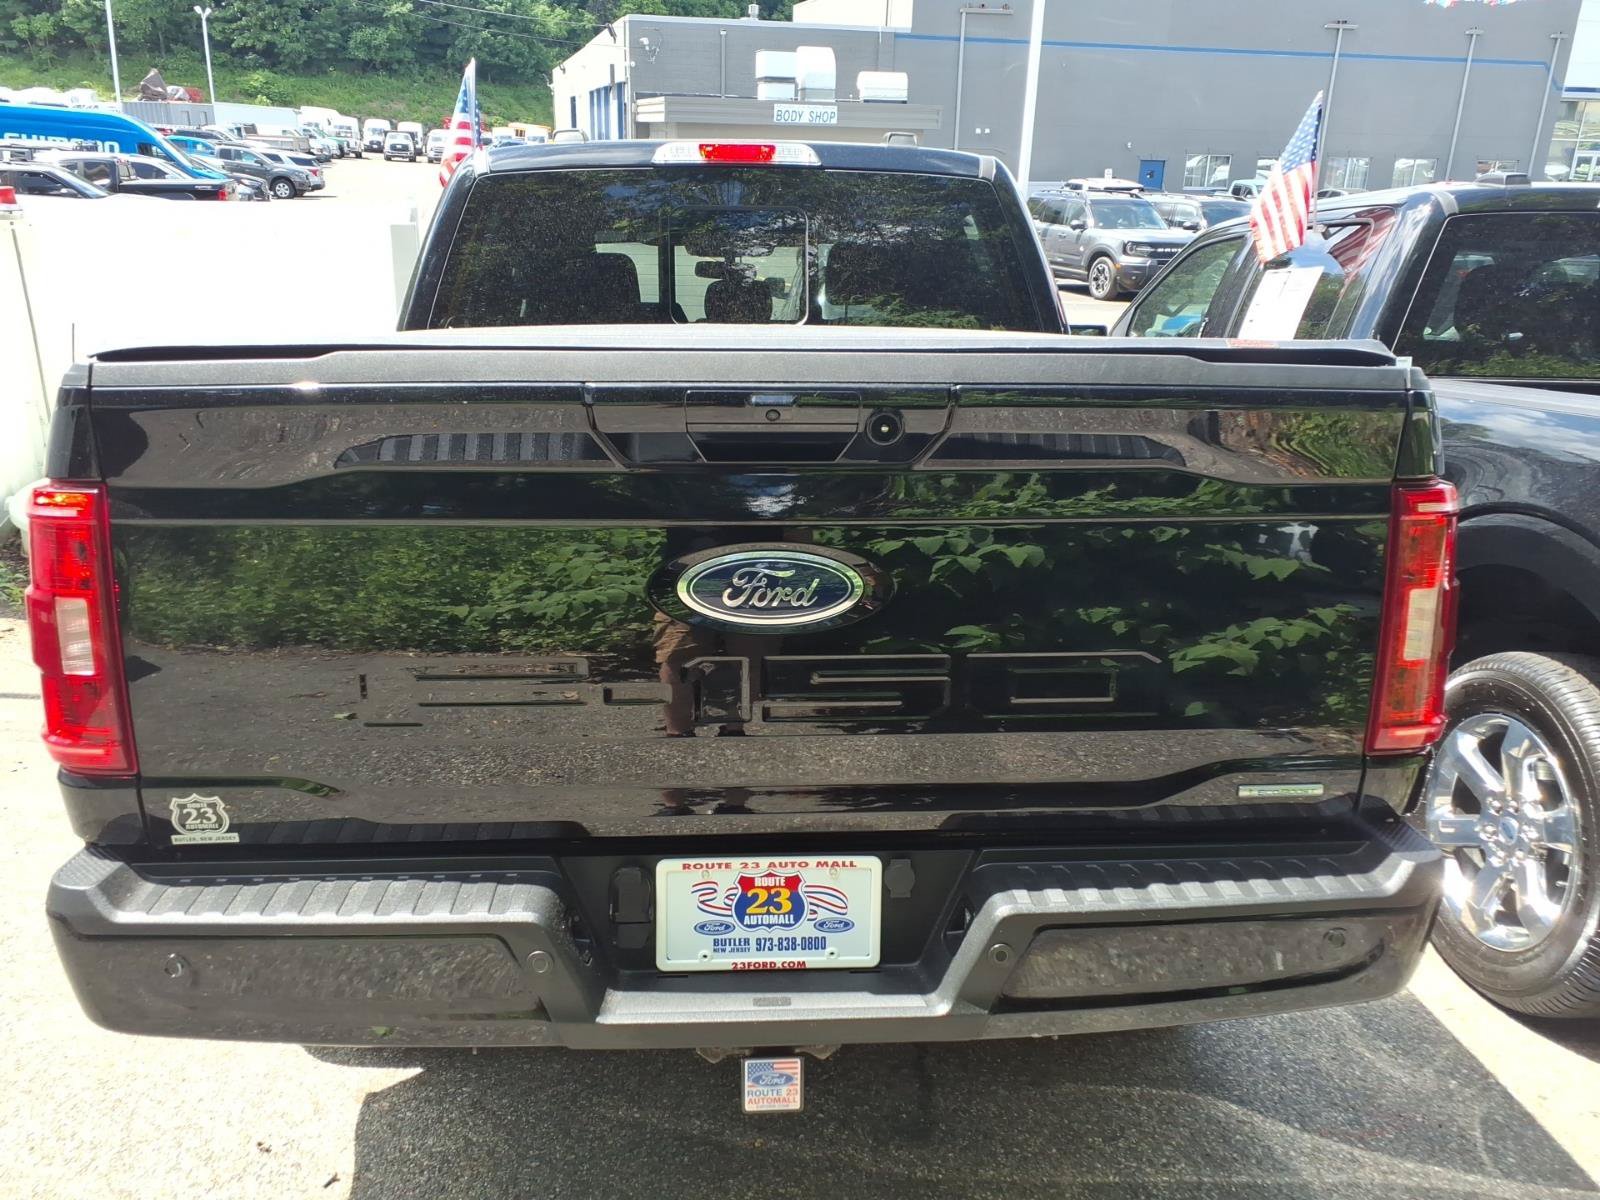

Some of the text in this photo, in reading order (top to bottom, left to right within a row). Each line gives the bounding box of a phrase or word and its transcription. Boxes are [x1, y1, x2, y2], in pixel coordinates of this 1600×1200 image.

[776, 109, 836, 123] BODY SHOP
[722, 567, 819, 608] Ford
[183, 808, 217, 824] 23
[682, 862, 732, 870] ROUTE
[816, 860, 857, 868] MALL
[754, 876, 786, 887] ROUTE
[746, 887, 793, 915] 23
[744, 914, 795, 926] AUTOMALL
[713, 936, 827, 952] BUTLER 973-838-0800
[731, 960, 807, 970] 23FORD.COM
[760, 1074, 785, 1085] Ford
[787, 1088, 798, 1096] 23
[747, 1097, 798, 1105] AUTOMALL
